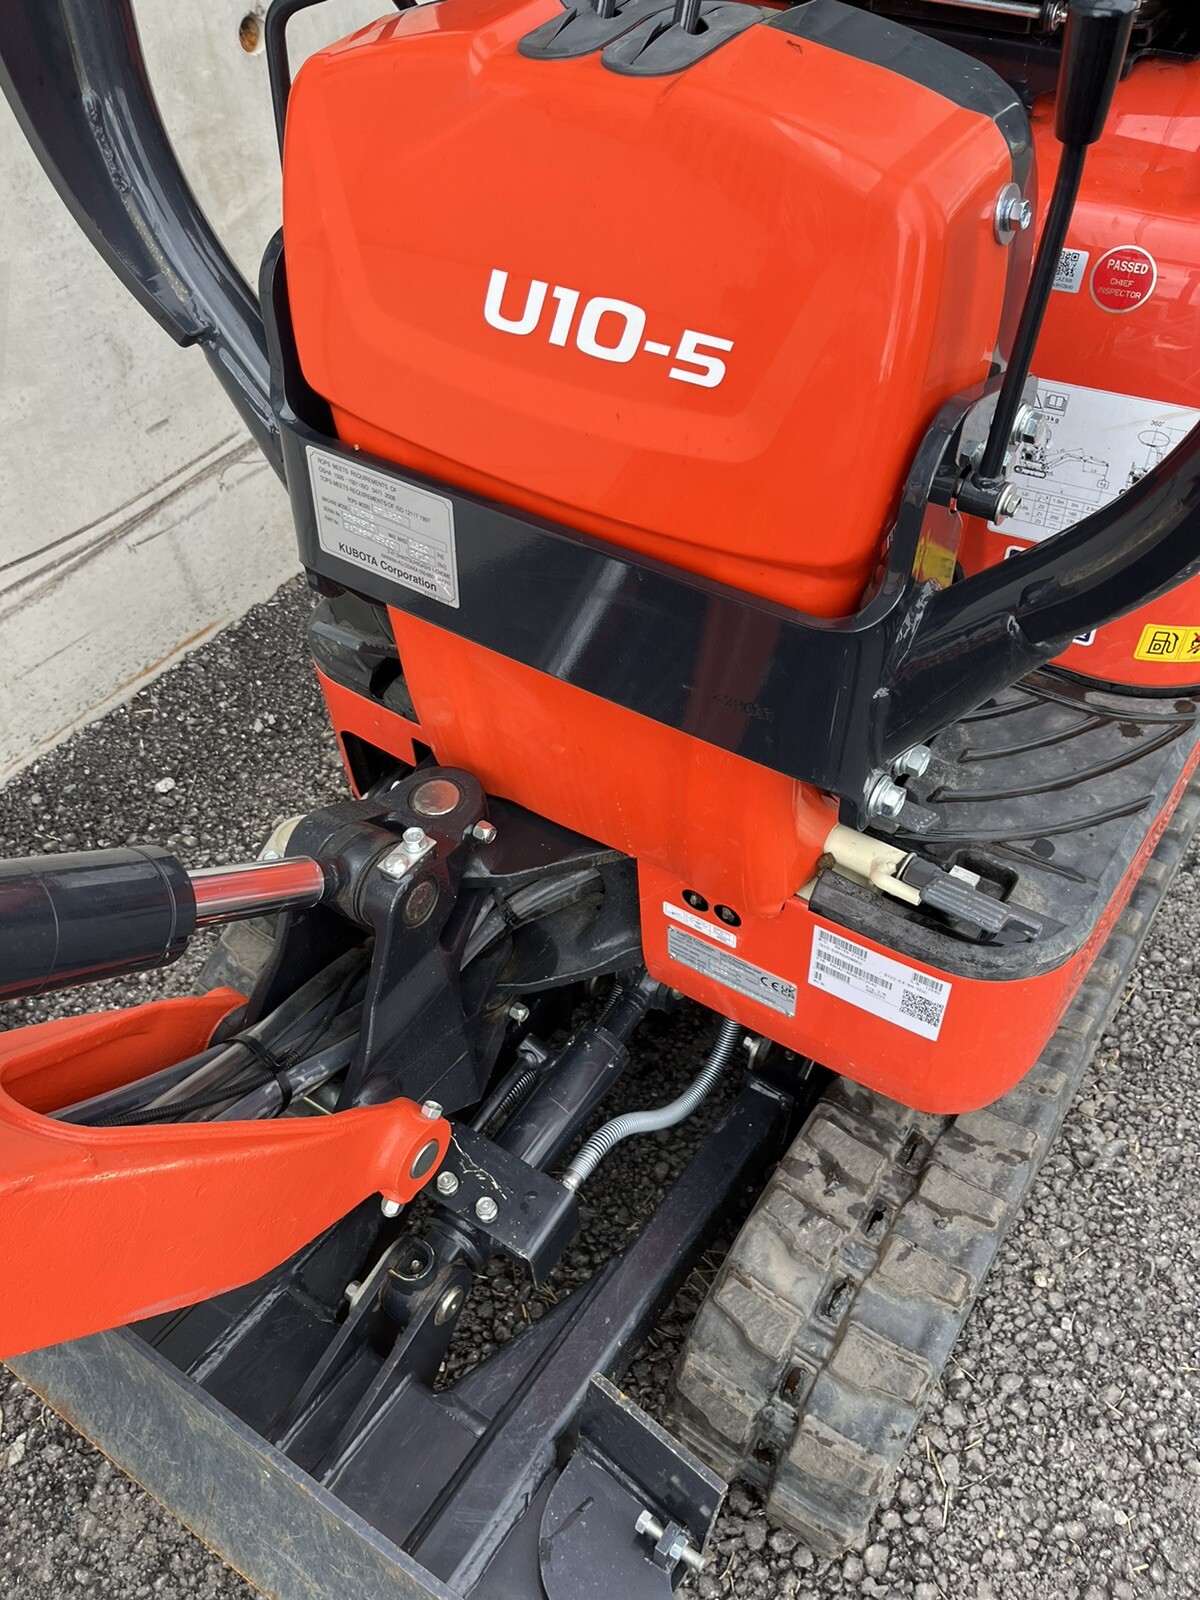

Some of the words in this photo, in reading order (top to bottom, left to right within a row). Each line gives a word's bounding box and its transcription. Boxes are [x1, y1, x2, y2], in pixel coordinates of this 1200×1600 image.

[1106, 258, 1149, 275] PASSED
[1109, 277, 1134, 287] CHIEF
[1097, 286, 1142, 299] INSPECTOR
[484, 268, 735, 388] U10-5
[332, 463, 348, 475] MEETS
[350, 469, 388, 490] REQUIREMENTS
[389, 485, 397, 493] OF
[349, 486, 387, 507] REQUIREMENTS
[338, 541, 377, 567] KUBOTA
[380, 559, 436, 593] Corporation
[1153, 642, 1161, 651] D
